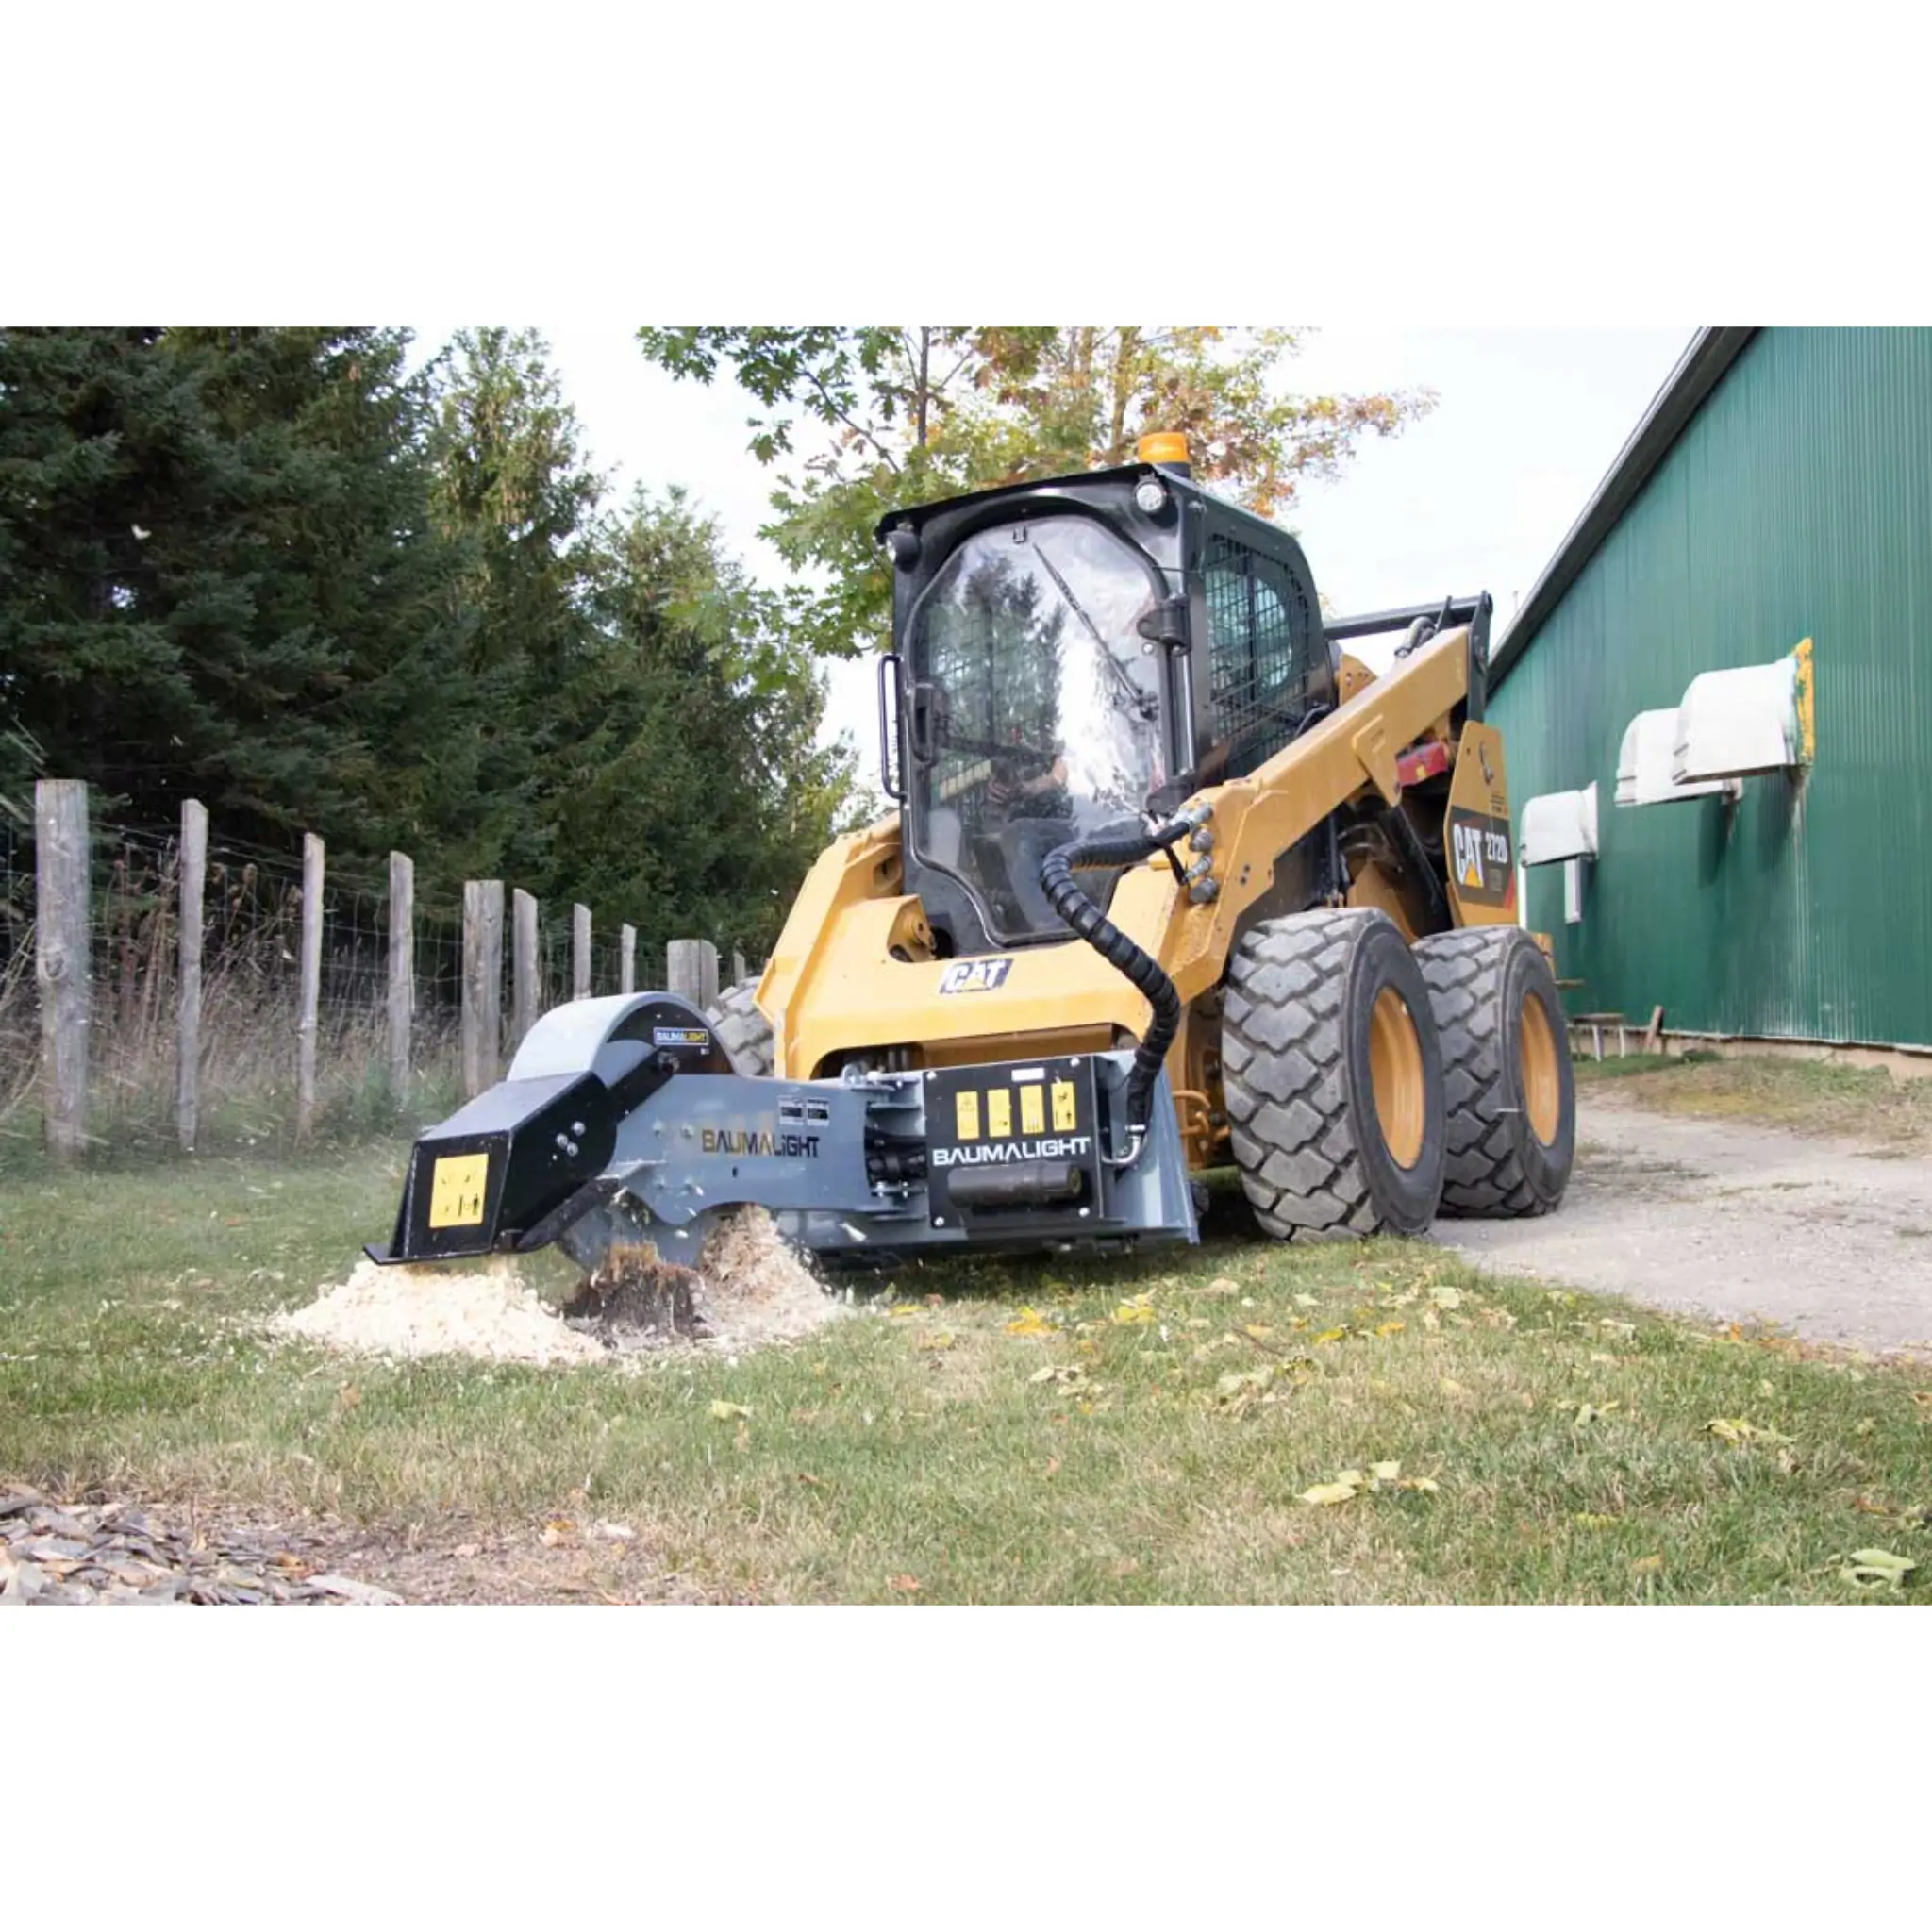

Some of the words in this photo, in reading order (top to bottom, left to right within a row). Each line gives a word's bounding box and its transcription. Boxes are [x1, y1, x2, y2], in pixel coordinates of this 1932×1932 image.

[1454, 823, 1484, 888] CAT
[944, 959, 1006, 991] CAT
[702, 1129, 820, 1158] BAUMALIGHT
[932, 1136, 1091, 1167] BAUMALIGHT
